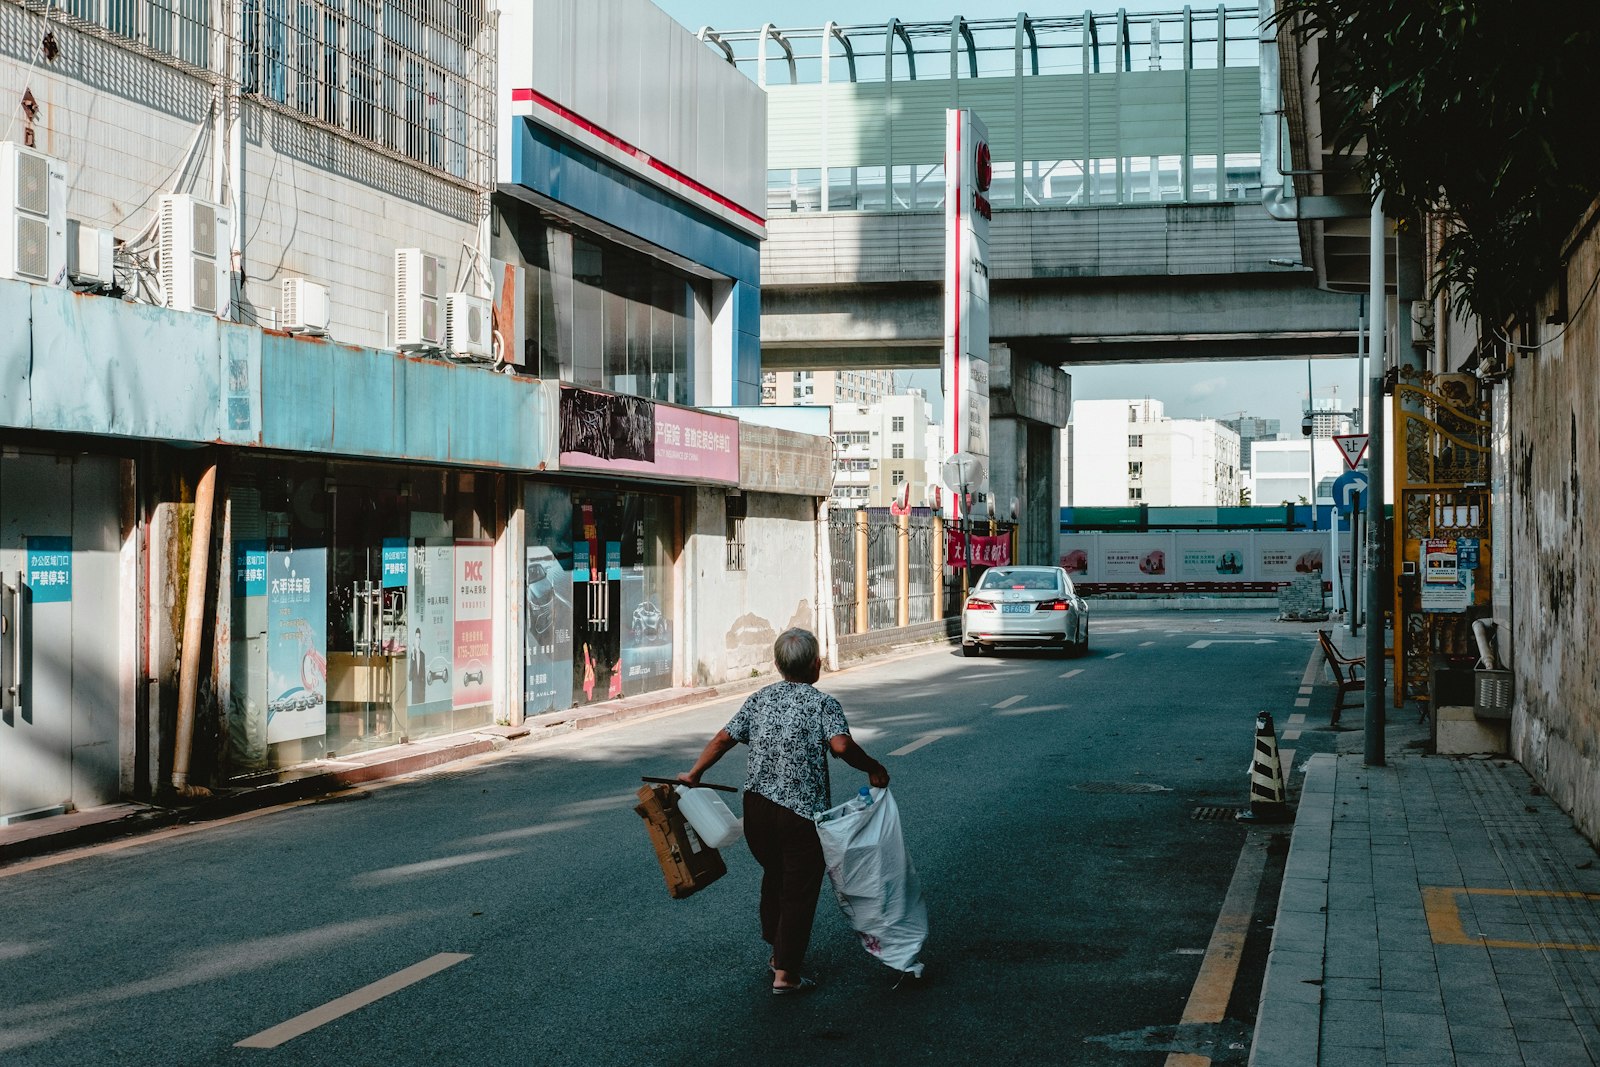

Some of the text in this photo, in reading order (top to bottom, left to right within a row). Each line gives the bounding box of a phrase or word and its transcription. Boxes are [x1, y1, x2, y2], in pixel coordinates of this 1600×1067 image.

[655, 421, 681, 446] 产保险
[1345, 440, 1359, 453] 让
[31, 555, 69, 566] 办公区域门口
[464, 561, 483, 582] PICC
[271, 577, 311, 594] 太平洋车险
[536, 690, 557, 698] AVALON
